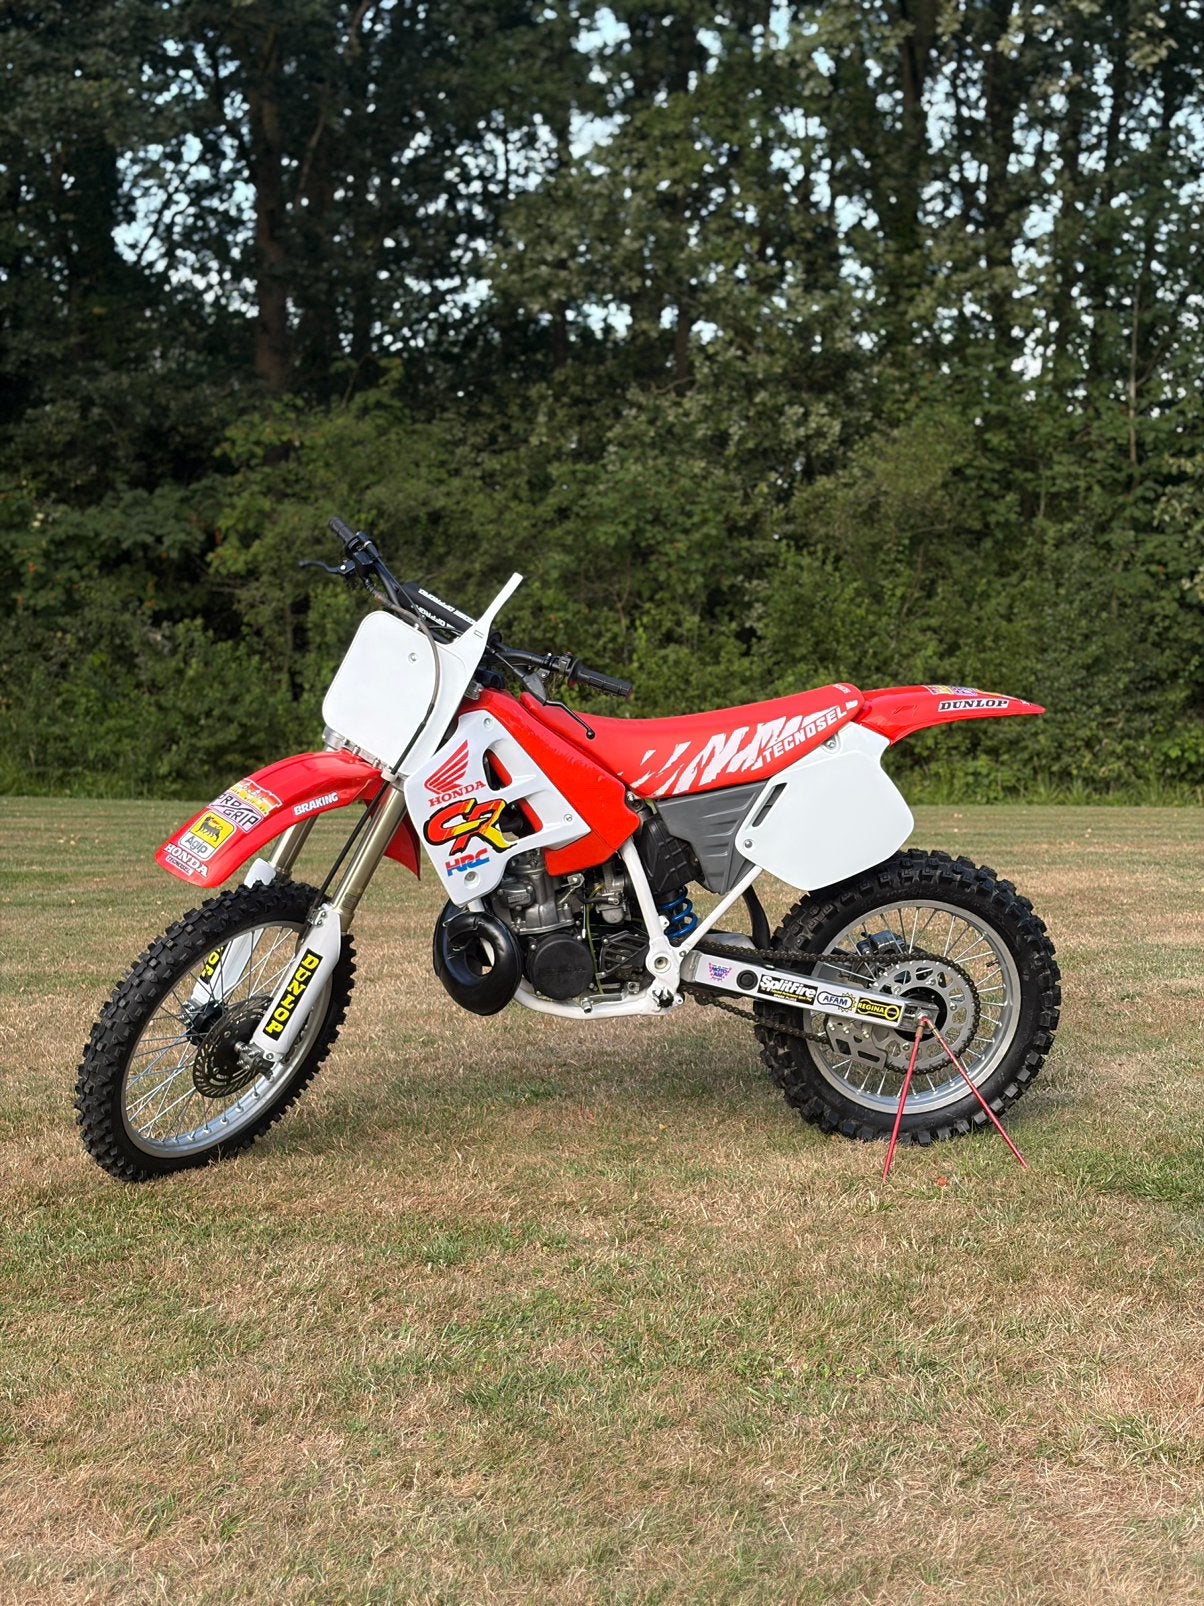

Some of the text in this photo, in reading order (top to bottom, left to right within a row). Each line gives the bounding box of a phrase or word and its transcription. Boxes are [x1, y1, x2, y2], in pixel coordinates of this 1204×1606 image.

[940, 700, 1008, 711] DUNLOP
[764, 707, 847, 763] TECNOSEL
[293, 792, 339, 816] BRAKING
[428, 780, 486, 807] HONDA
[223, 809, 259, 827] GRIP
[423, 797, 518, 856] CR
[184, 836, 209, 855] Agip
[164, 843, 210, 878] HONDA
[445, 848, 490, 877] HRC
[265, 953, 320, 1034] DUNLOP
[760, 975, 817, 999] SplitFire
[822, 995, 848, 1007] AFAM
[857, 1002, 885, 1014] REGINA
